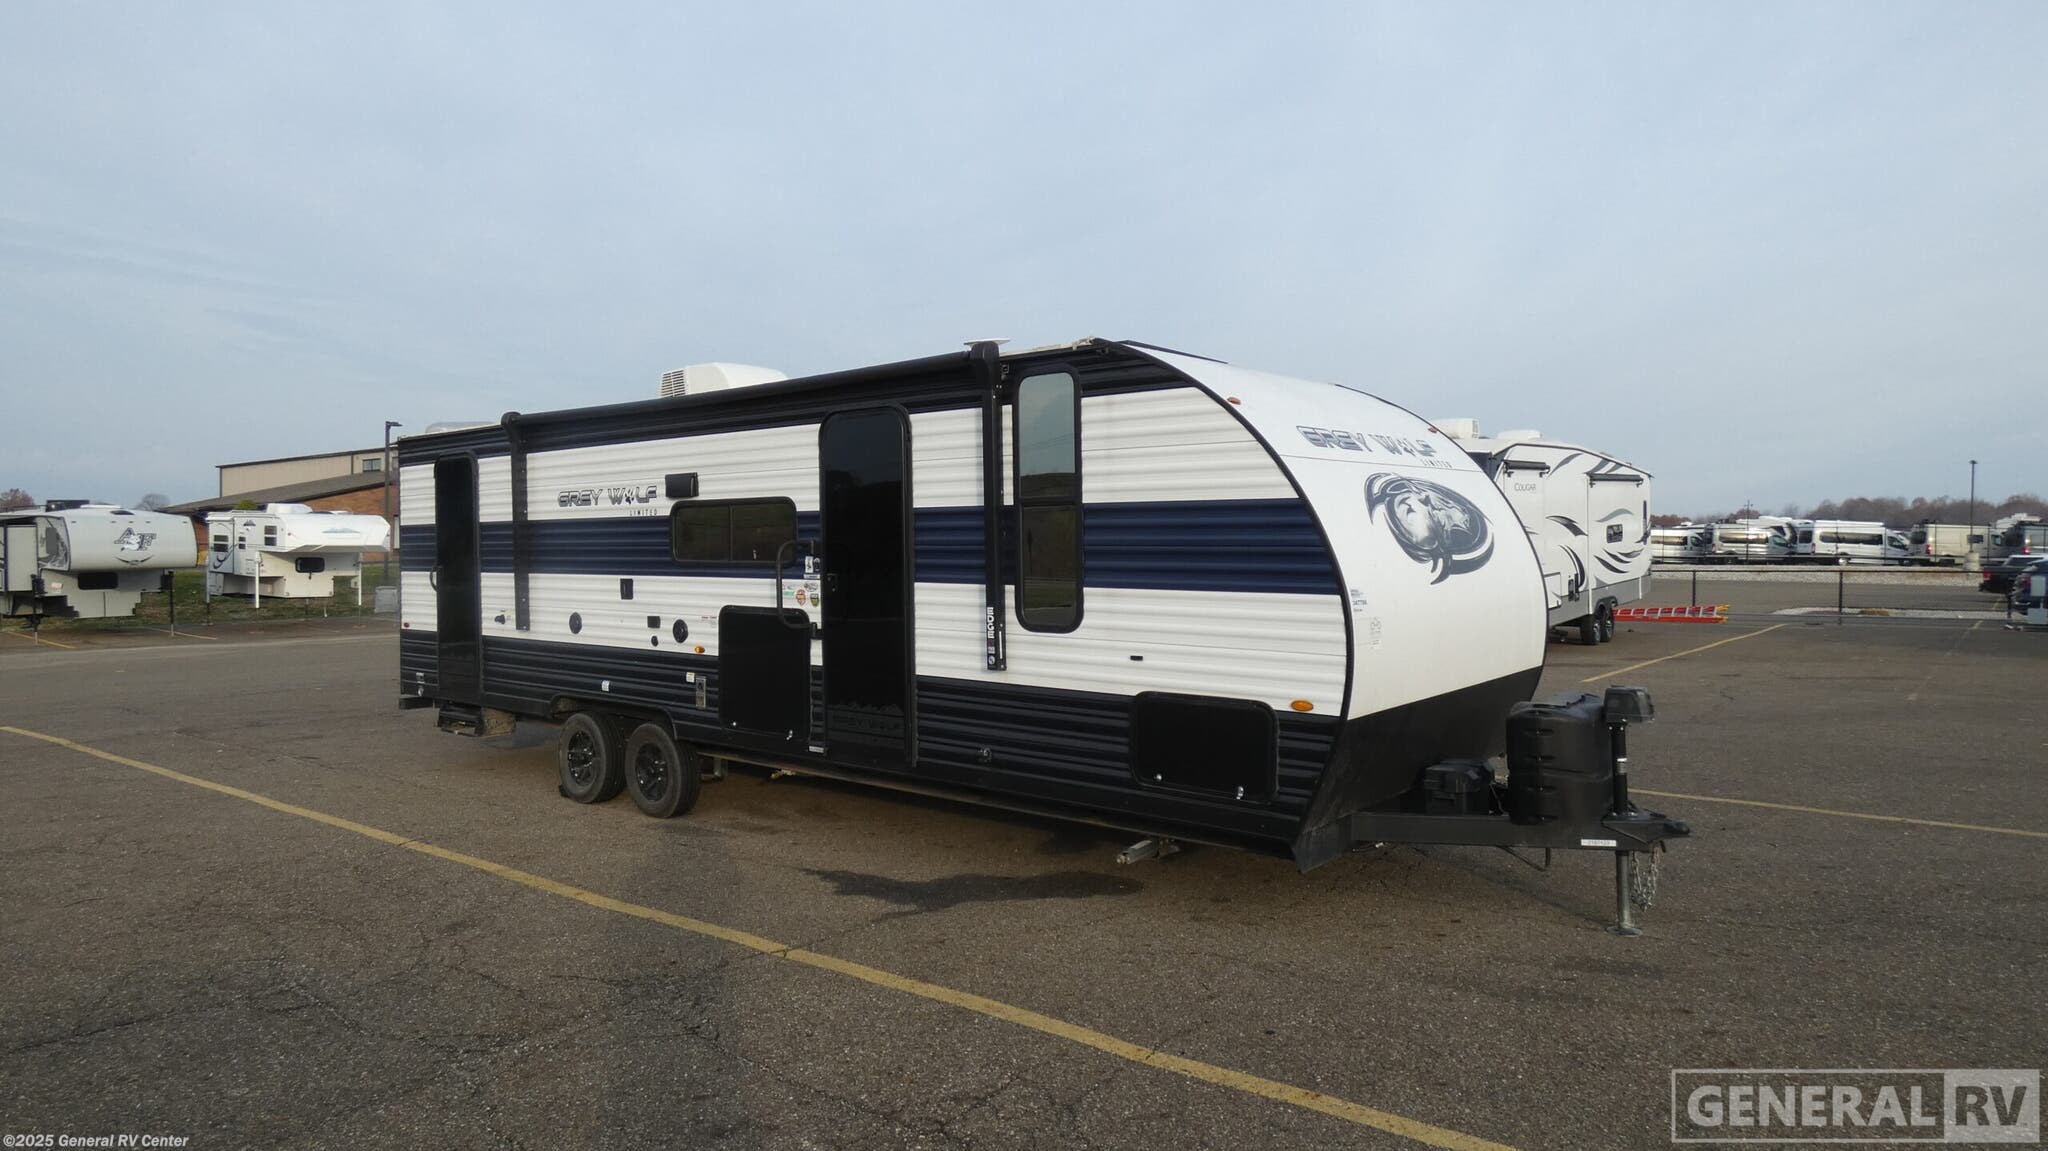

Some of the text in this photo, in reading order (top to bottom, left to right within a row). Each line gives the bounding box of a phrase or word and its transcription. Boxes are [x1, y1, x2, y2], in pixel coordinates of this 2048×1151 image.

[1296, 425, 1373, 453] GREY
[558, 488, 603, 507] GREY
[987, 606, 995, 639] EDGE
